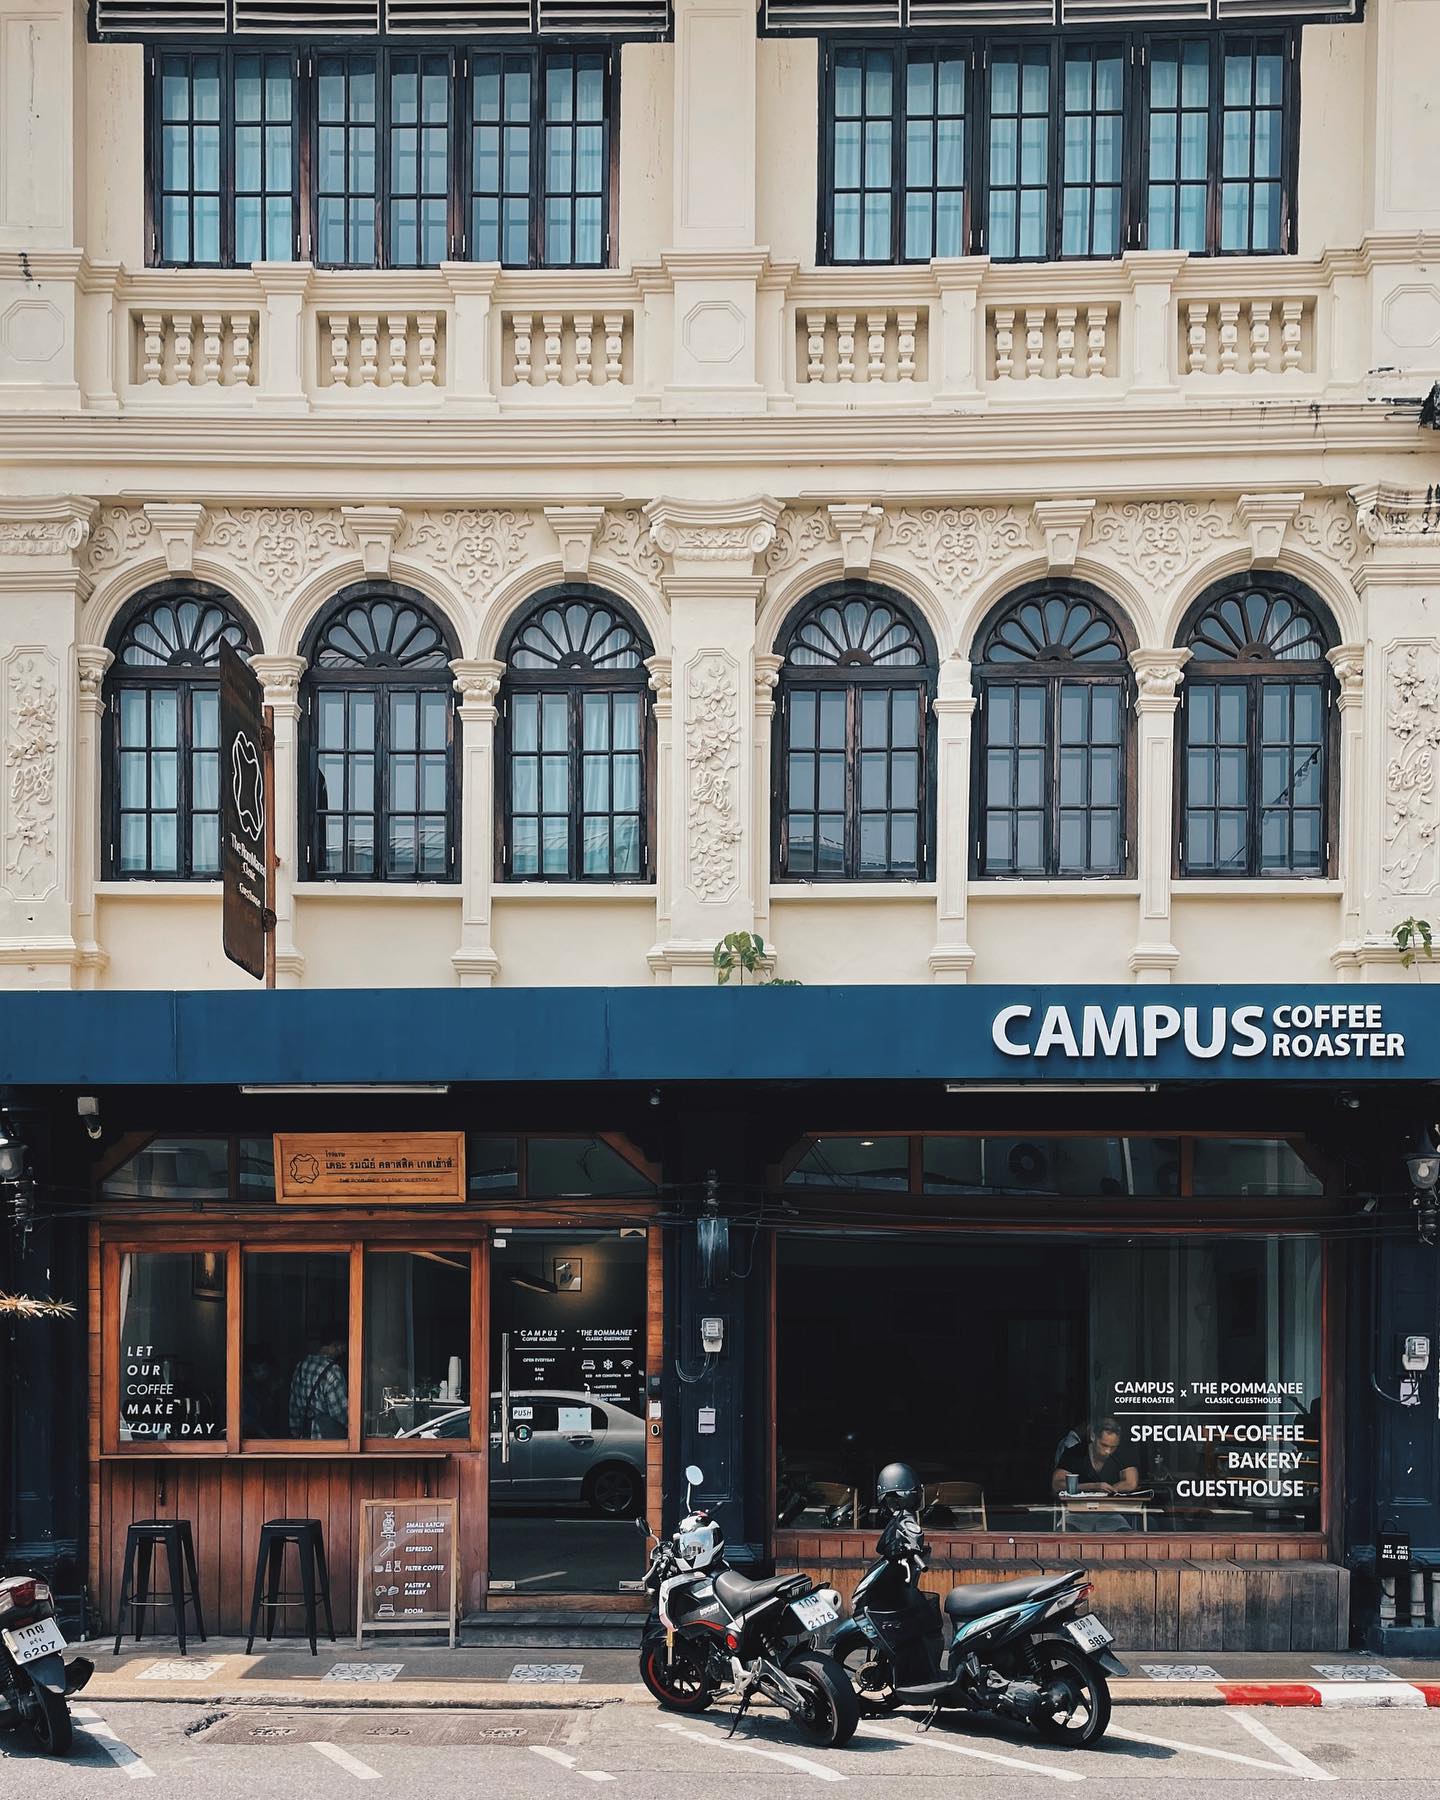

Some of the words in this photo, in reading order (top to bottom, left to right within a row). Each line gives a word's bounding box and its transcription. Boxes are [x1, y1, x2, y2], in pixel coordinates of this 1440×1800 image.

[1272, 1004, 1382, 1029] COFFEE
[992, 1004, 1267, 1059] CAMPUS
[1272, 1033, 1405, 1058] ROASTER
[127, 1346, 153, 1357] LET
[127, 1365, 160, 1376] OUR
[127, 1384, 174, 1395] COFFEE
[1114, 1381, 1175, 1394] CAMPUS
[1191, 1382, 1218, 1394] THE
[127, 1404, 174, 1414] MAKE
[513, 1409, 532, 1417] PUSH
[127, 1423, 172, 1434] YOUR
[181, 1423, 215, 1434] DAY
[1130, 1425, 1229, 1442] SPECIALTY
[1233, 1425, 1304, 1442] COFFEE
[1228, 1452, 1303, 1469] BAKERY
[1176, 1480, 1304, 1497] GUESTHOUSE
[808, 1611, 835, 1628] 2176
[1088, 1634, 1107, 1648] 988
[23, 1641, 56, 1659] 6207
